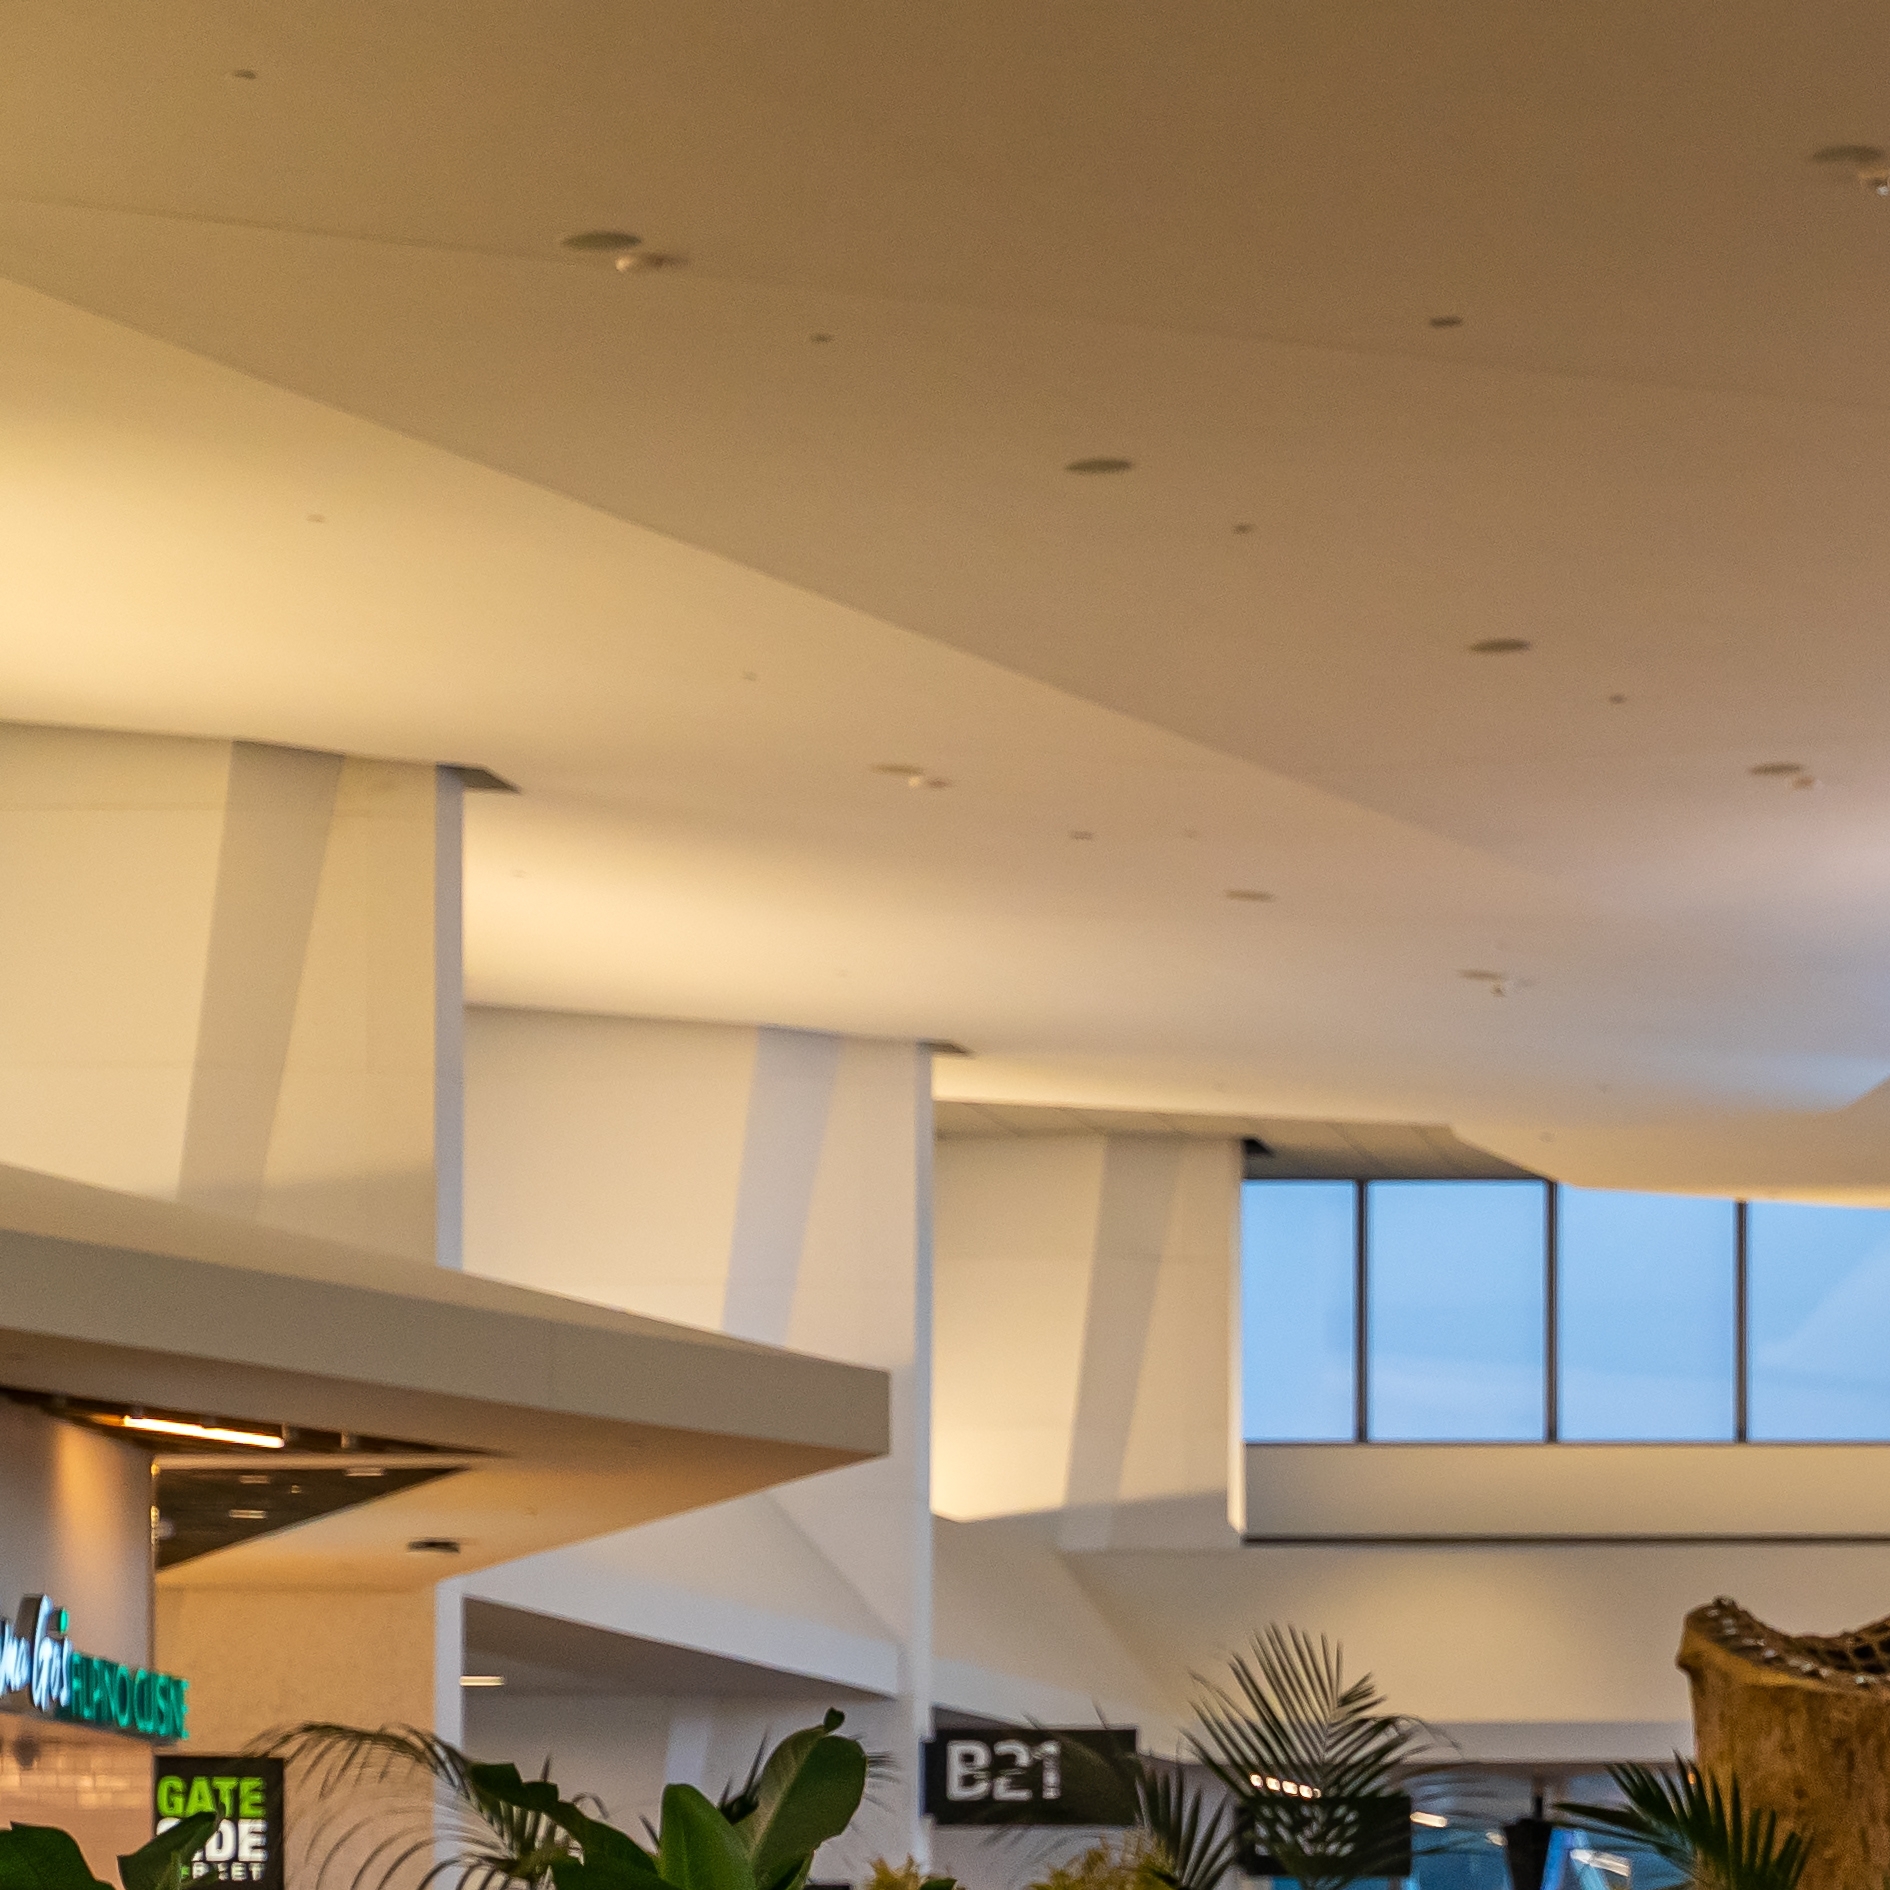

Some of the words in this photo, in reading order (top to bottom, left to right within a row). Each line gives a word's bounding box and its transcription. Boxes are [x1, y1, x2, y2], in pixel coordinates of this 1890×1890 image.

[946, 1739, 1061, 1801] B21
[157, 1775, 266, 1818] GATE
[156, 1817, 269, 1861] DE
